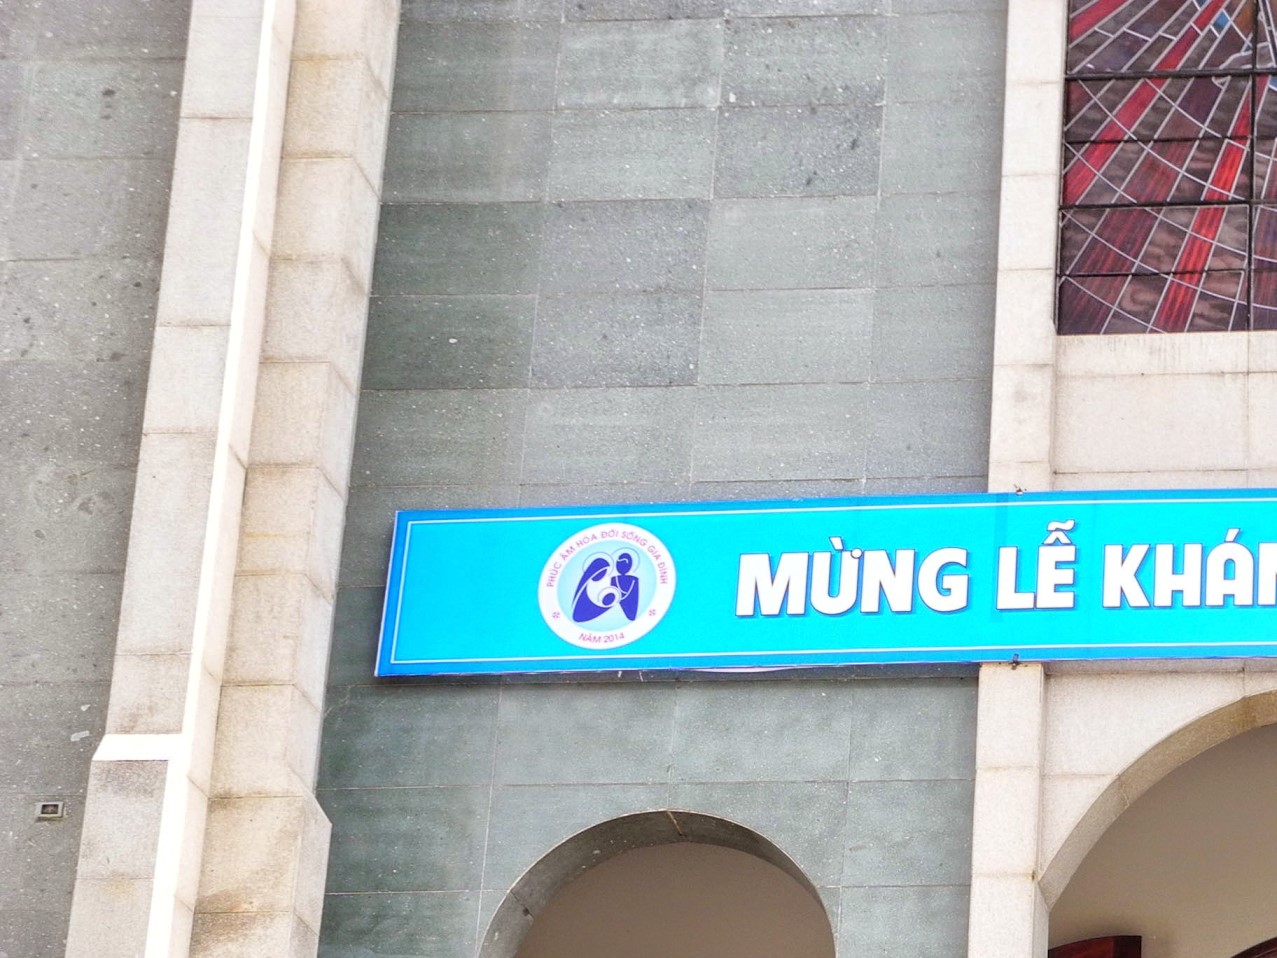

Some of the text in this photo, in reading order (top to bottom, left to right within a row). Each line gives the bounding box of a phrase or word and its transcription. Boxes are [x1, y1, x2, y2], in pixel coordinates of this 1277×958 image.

[546, 529, 668, 588] PHÚC ÂM HÓA ĐỜI SỐNG GIA ĐÌNH
[734, 535, 970, 617] MỪNG
[995, 519, 1078, 611] LỄ
[578, 632, 625, 643] NĂM 2014
